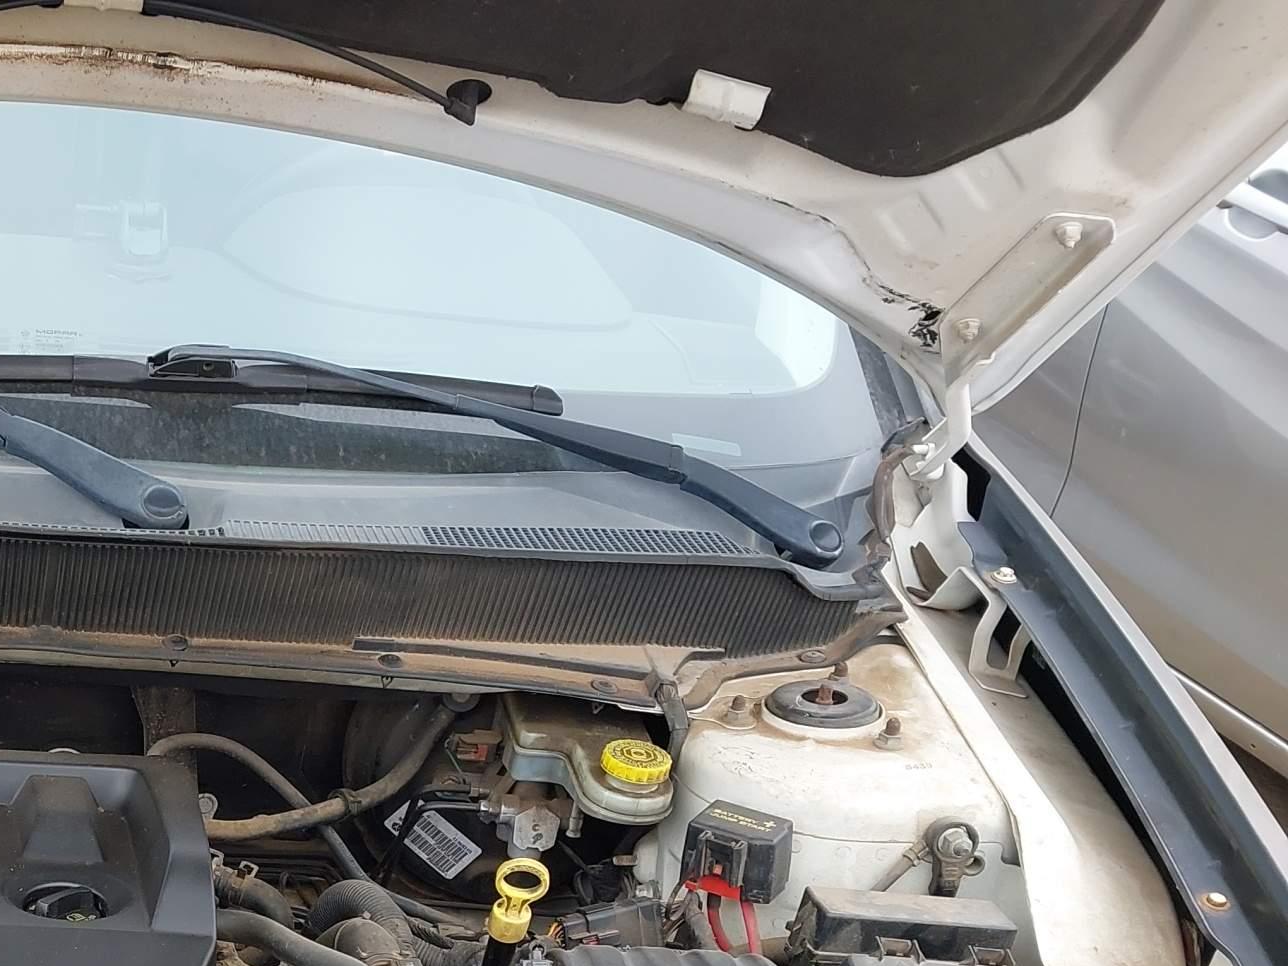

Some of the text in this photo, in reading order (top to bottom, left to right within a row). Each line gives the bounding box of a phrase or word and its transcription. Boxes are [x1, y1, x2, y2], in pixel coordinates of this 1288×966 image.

[710, 812, 773, 832] JUMP START
[713, 808, 759, 824] BATTERY
